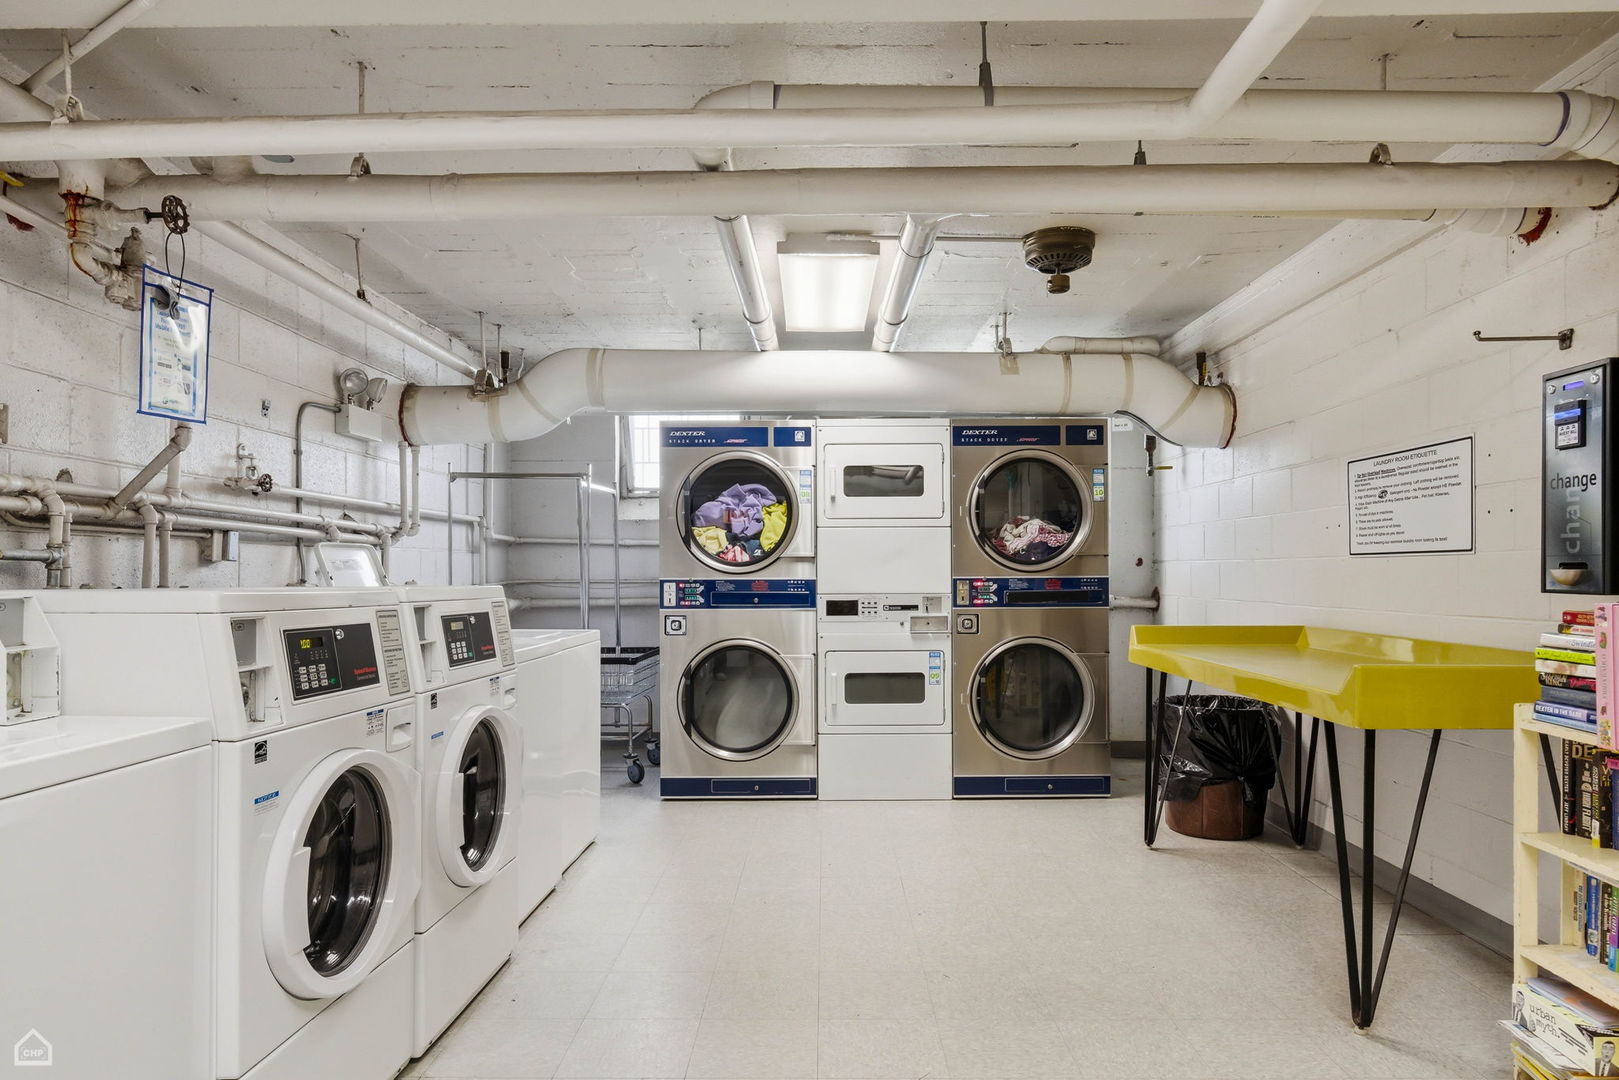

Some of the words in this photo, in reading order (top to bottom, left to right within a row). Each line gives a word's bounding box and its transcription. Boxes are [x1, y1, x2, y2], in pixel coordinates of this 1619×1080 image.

[1373, 458, 1393, 466] LAUNDRY
[1410, 449, 1436, 459] ETIQUETTE
[1550, 472, 1596, 492] change
[1536, 704, 1553, 713] DEXTER
[1529, 1004, 1557, 1025] urban
[1536, 1018, 1560, 1039] myth.
